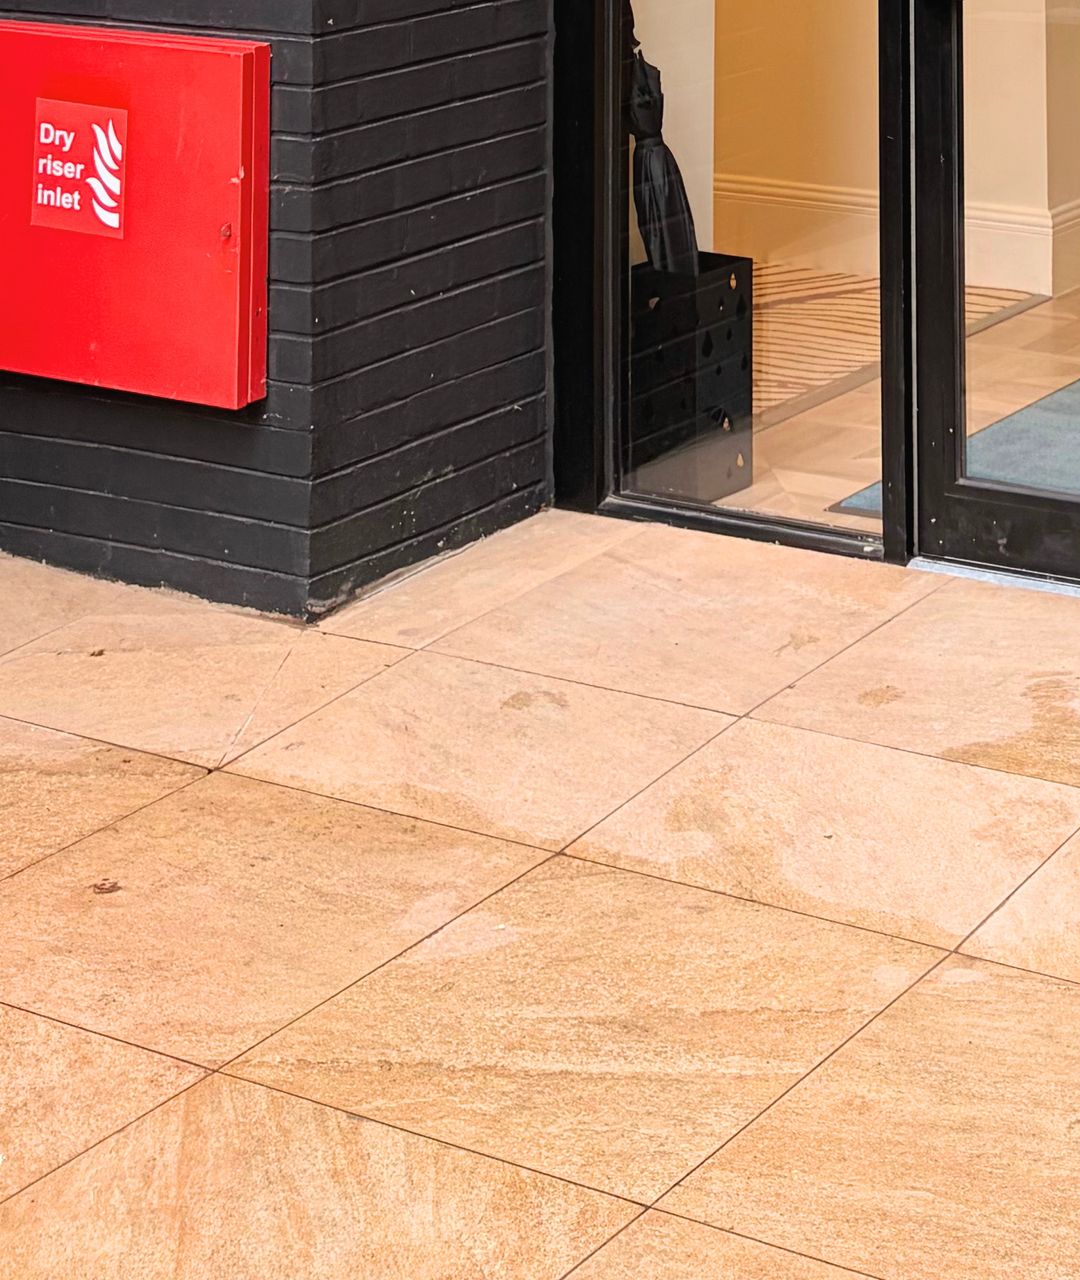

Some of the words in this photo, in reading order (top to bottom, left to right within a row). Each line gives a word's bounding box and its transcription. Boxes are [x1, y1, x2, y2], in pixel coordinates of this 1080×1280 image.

[40, 122, 76, 152] Dry
[38, 154, 85, 179] riser
[37, 183, 81, 211] inlet
